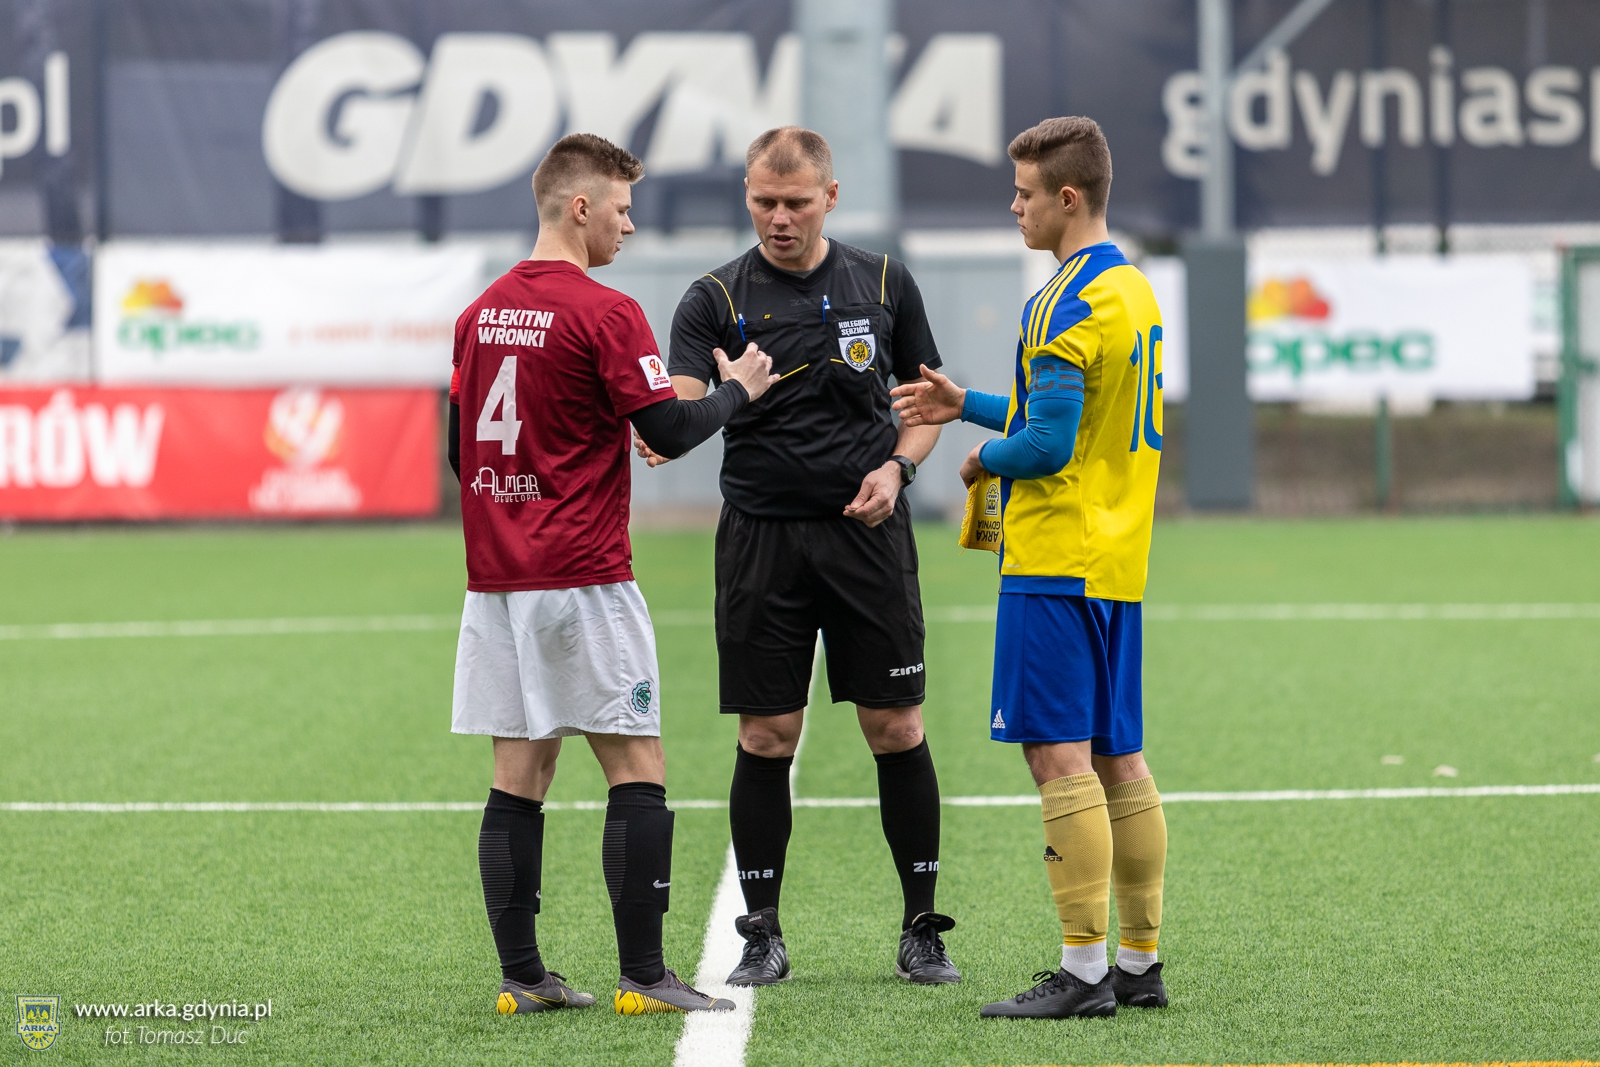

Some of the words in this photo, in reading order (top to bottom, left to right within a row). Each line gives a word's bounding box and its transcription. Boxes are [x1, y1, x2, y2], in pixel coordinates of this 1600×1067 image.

[262, 30, 1004, 200] GDYNA
[477, 308, 555, 328] BŁĘKITNI
[838, 318, 870, 330] KOLEGIUM
[477, 326, 546, 348] WRONKI
[840, 325, 870, 337] SĘDZIÓW
[476, 355, 522, 456] 4
[478, 466, 540, 496] ALMAR
[494, 493, 542, 504] DEVELOPER
[977, 519, 1001, 531] GDYNIA
[976, 529, 999, 543] ARKA
